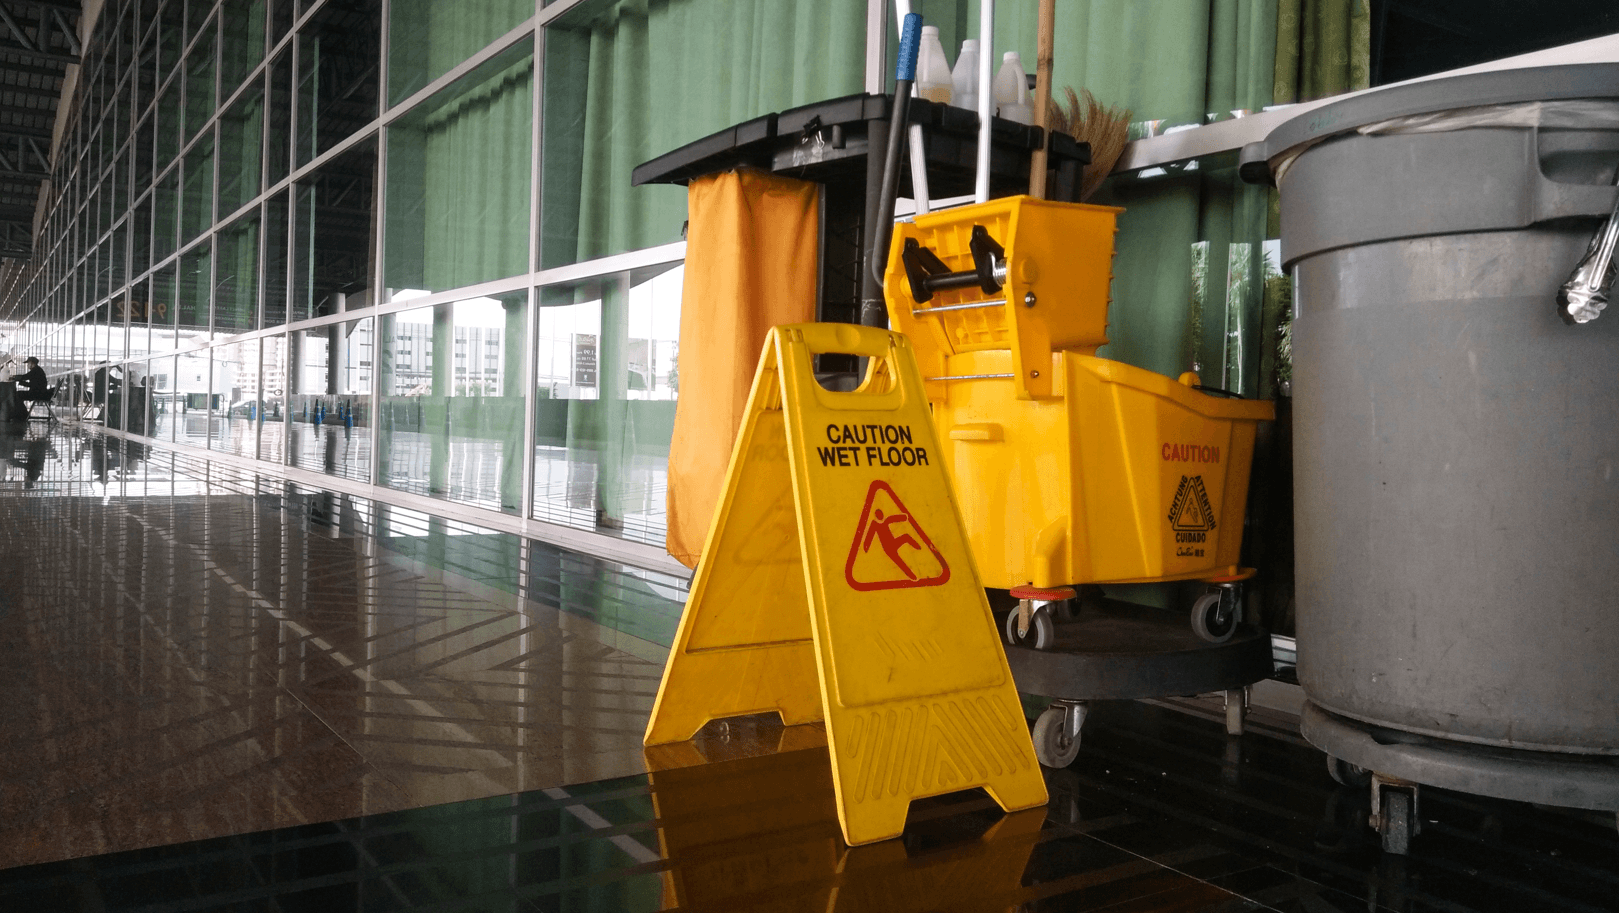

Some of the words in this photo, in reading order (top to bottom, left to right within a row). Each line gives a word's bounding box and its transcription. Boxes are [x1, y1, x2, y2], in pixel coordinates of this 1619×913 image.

[826, 424, 913, 444] CAUTION
[817, 447, 860, 466] WET
[866, 447, 929, 466] FLOOR
[1162, 443, 1220, 463] CAUTION
[1167, 475, 1188, 524] ACHTUNG
[1195, 475, 1217, 531] ATTENTION
[1175, 532, 1206, 543] CUIDADO
